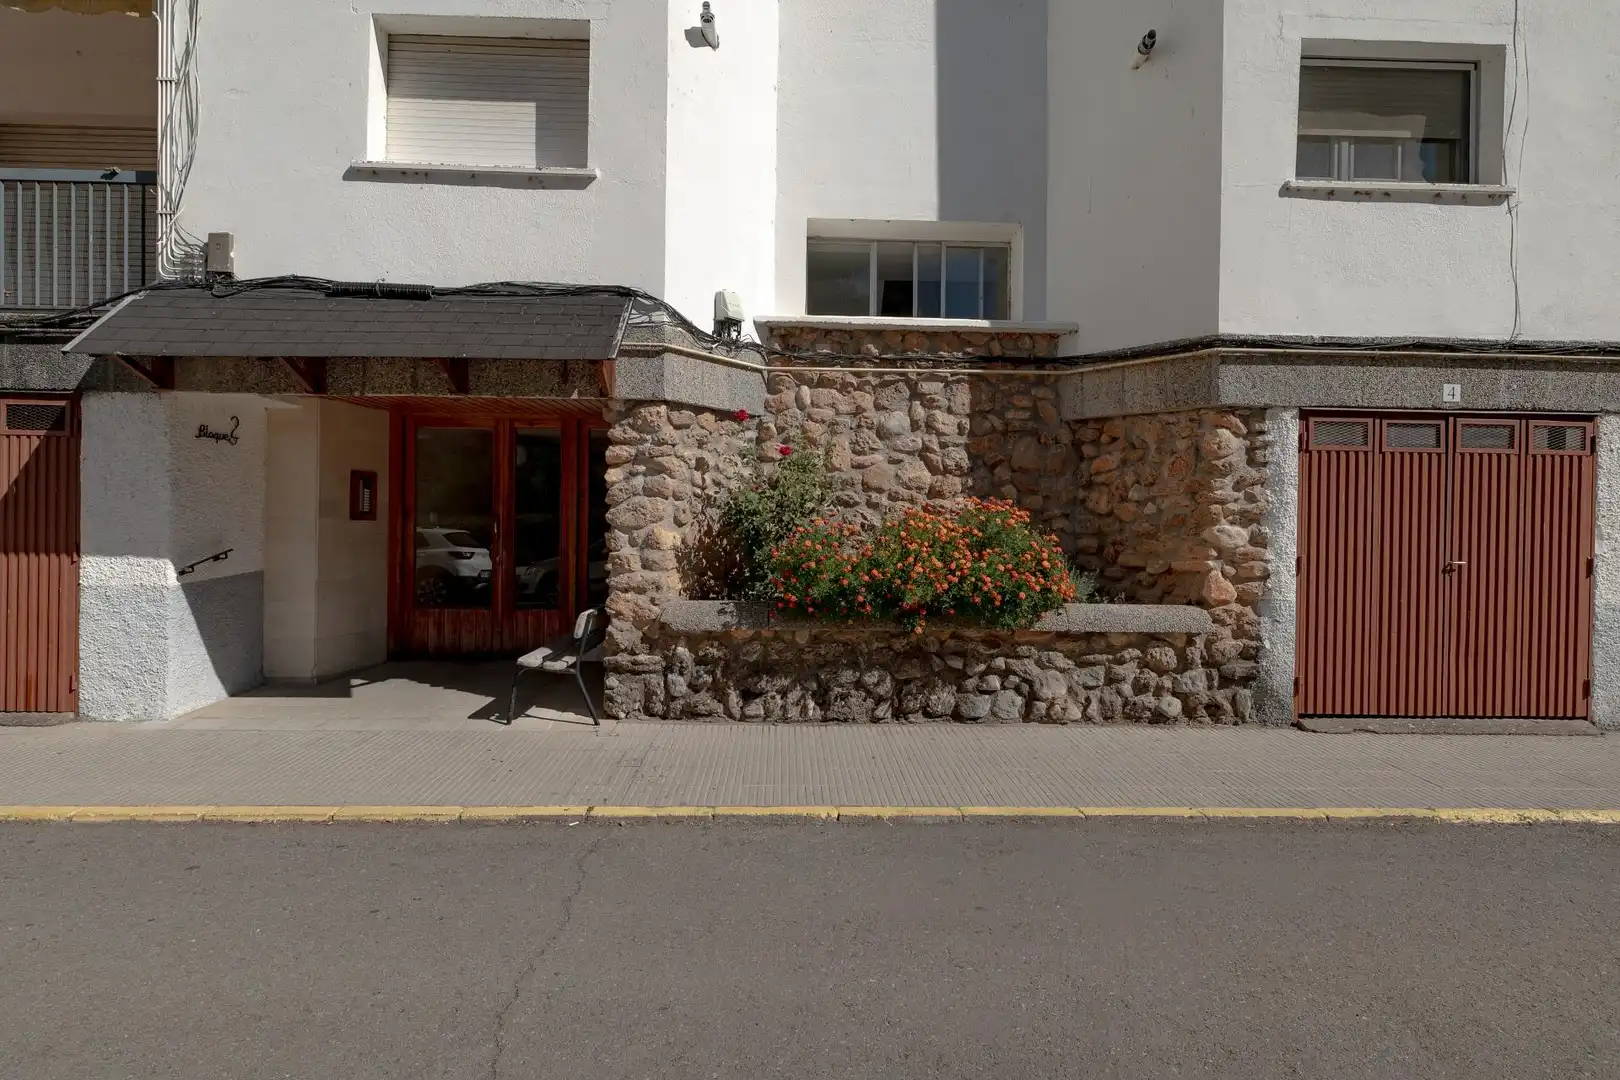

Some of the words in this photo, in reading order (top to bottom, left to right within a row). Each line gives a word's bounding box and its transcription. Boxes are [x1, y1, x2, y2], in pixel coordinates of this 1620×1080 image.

[1447, 387, 1457, 400] 4
[195, 424, 229, 444] Bloque
[228, 416, 240, 446] 2
